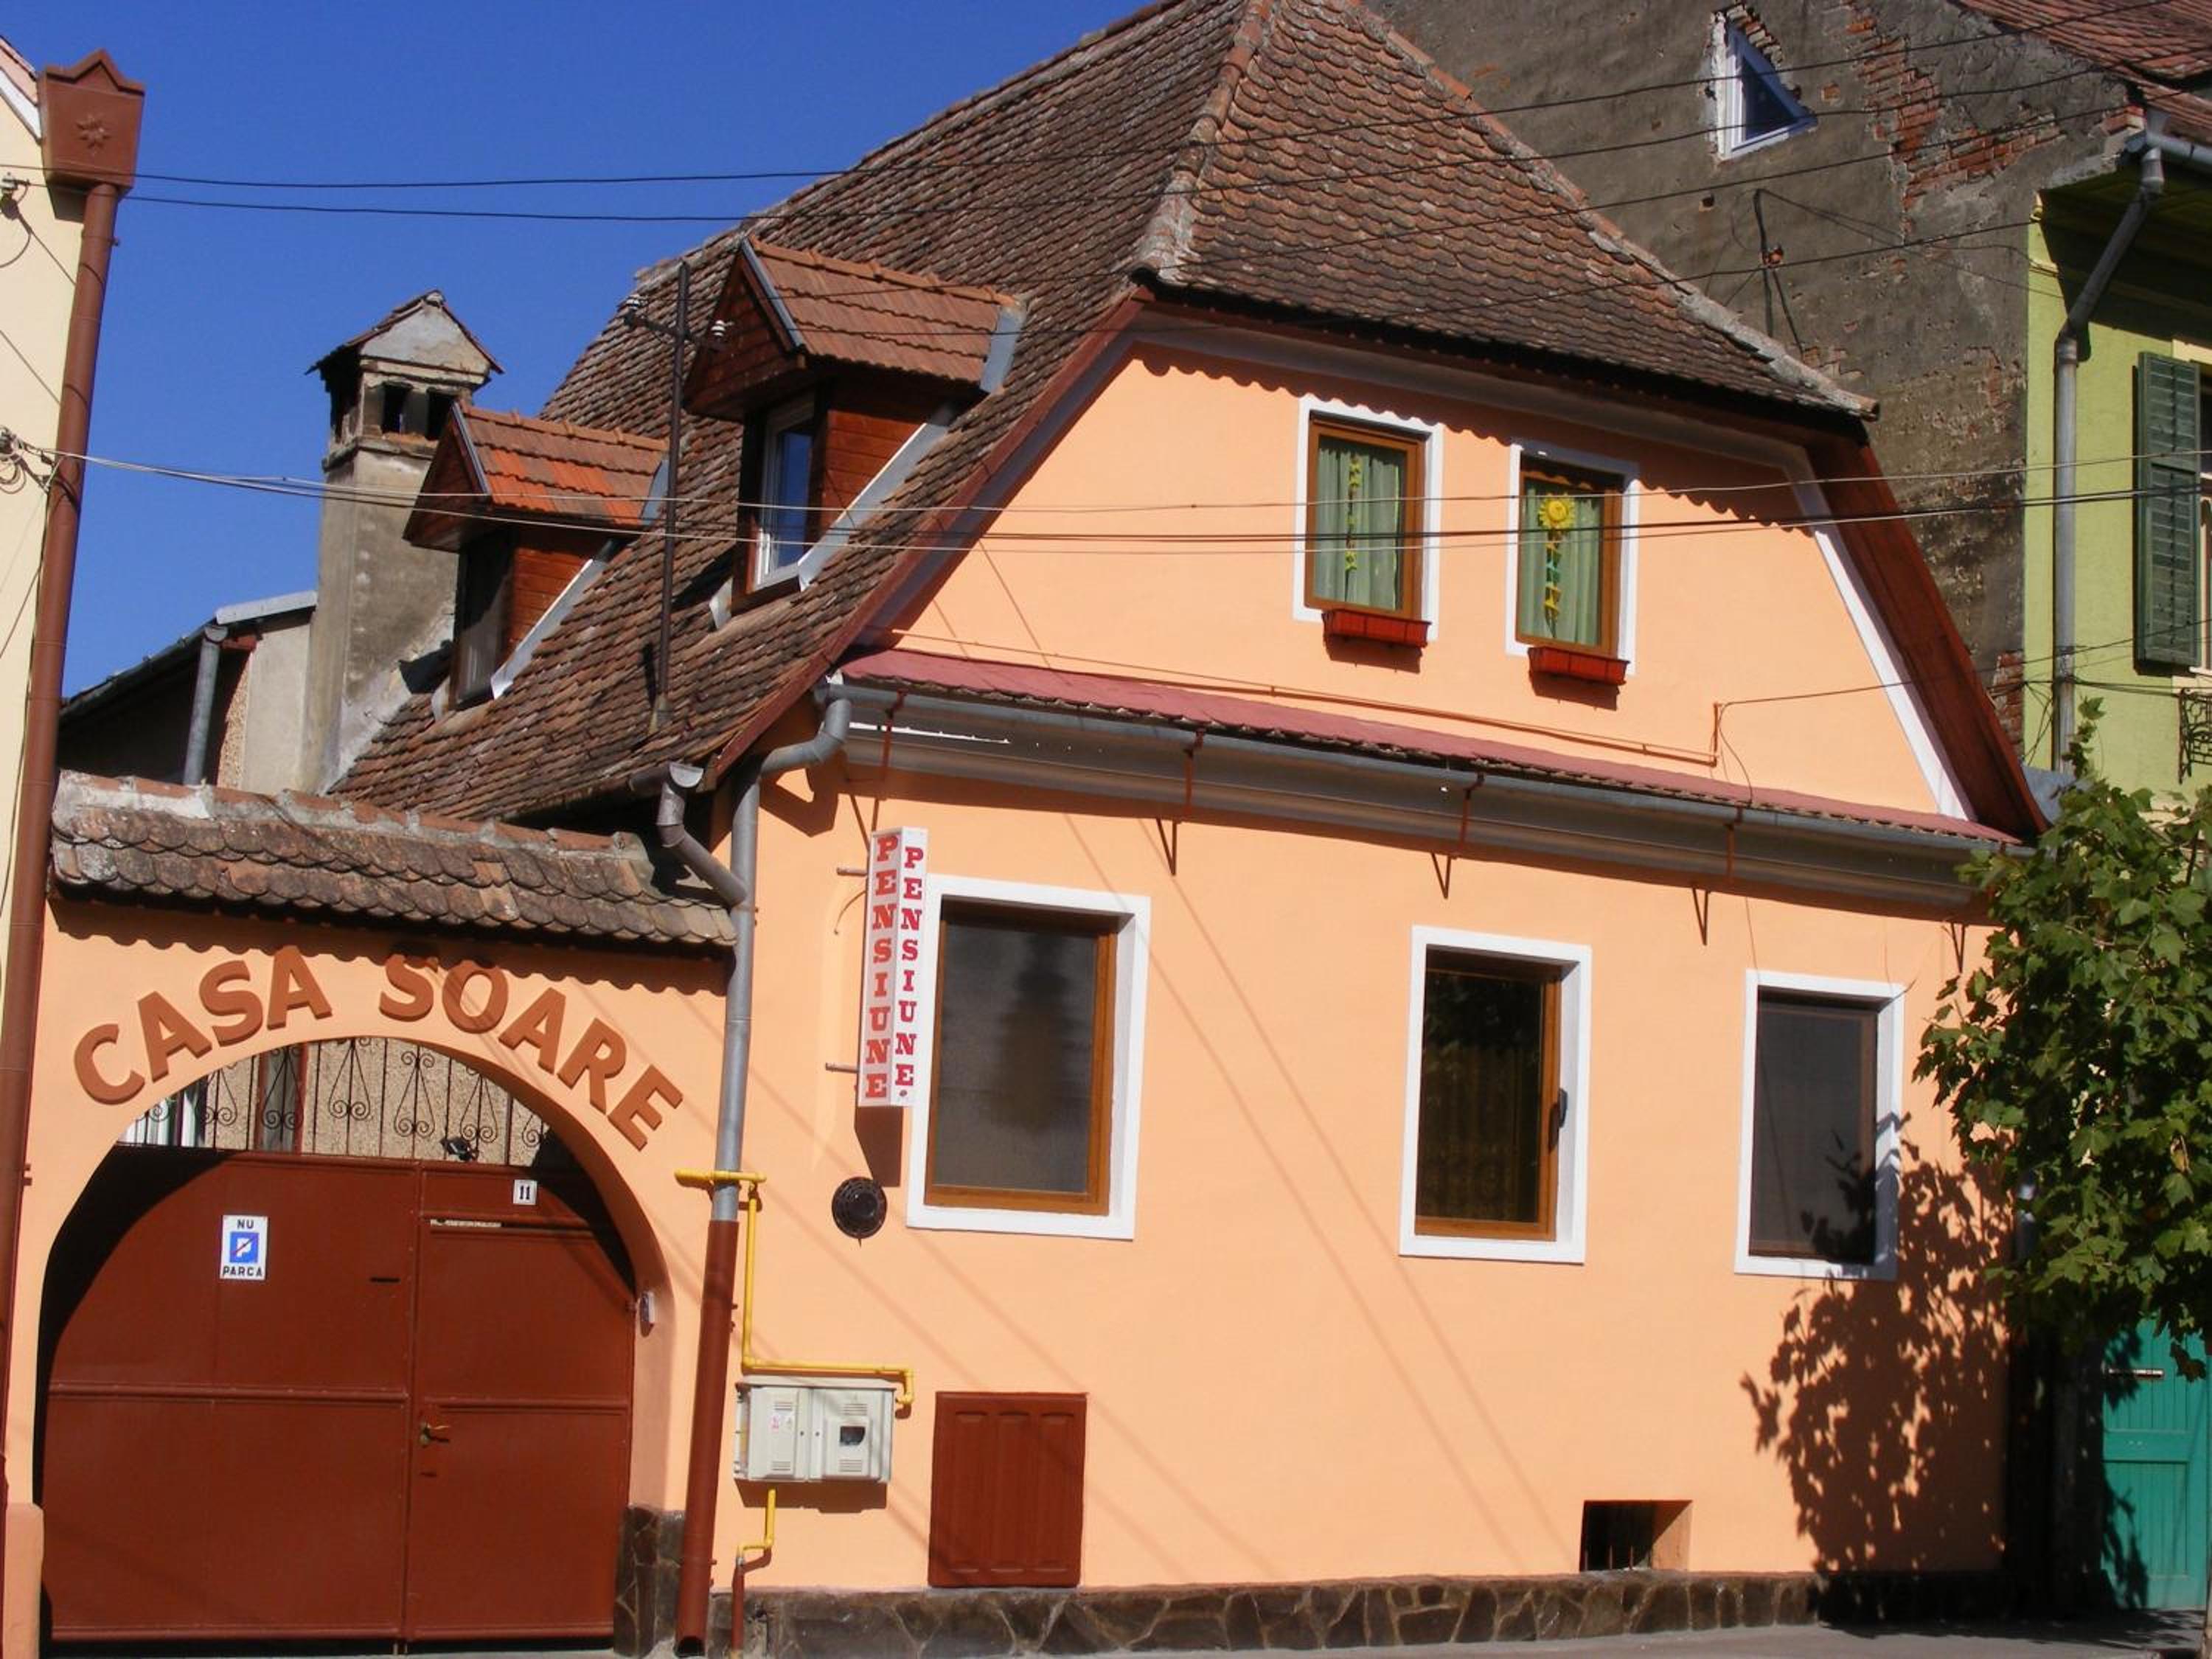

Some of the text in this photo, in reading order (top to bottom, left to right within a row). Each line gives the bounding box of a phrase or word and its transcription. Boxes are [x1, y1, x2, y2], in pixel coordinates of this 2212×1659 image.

[865, 835, 899, 1099] PENSIUNE
[894, 846, 925, 1086] PENSIUNE
[73, 945, 684, 1151] CASA SOARE
[237, 1220, 254, 1229] NU
[519, 1186, 530, 1200] 11
[223, 1265, 262, 1277] PARCA
